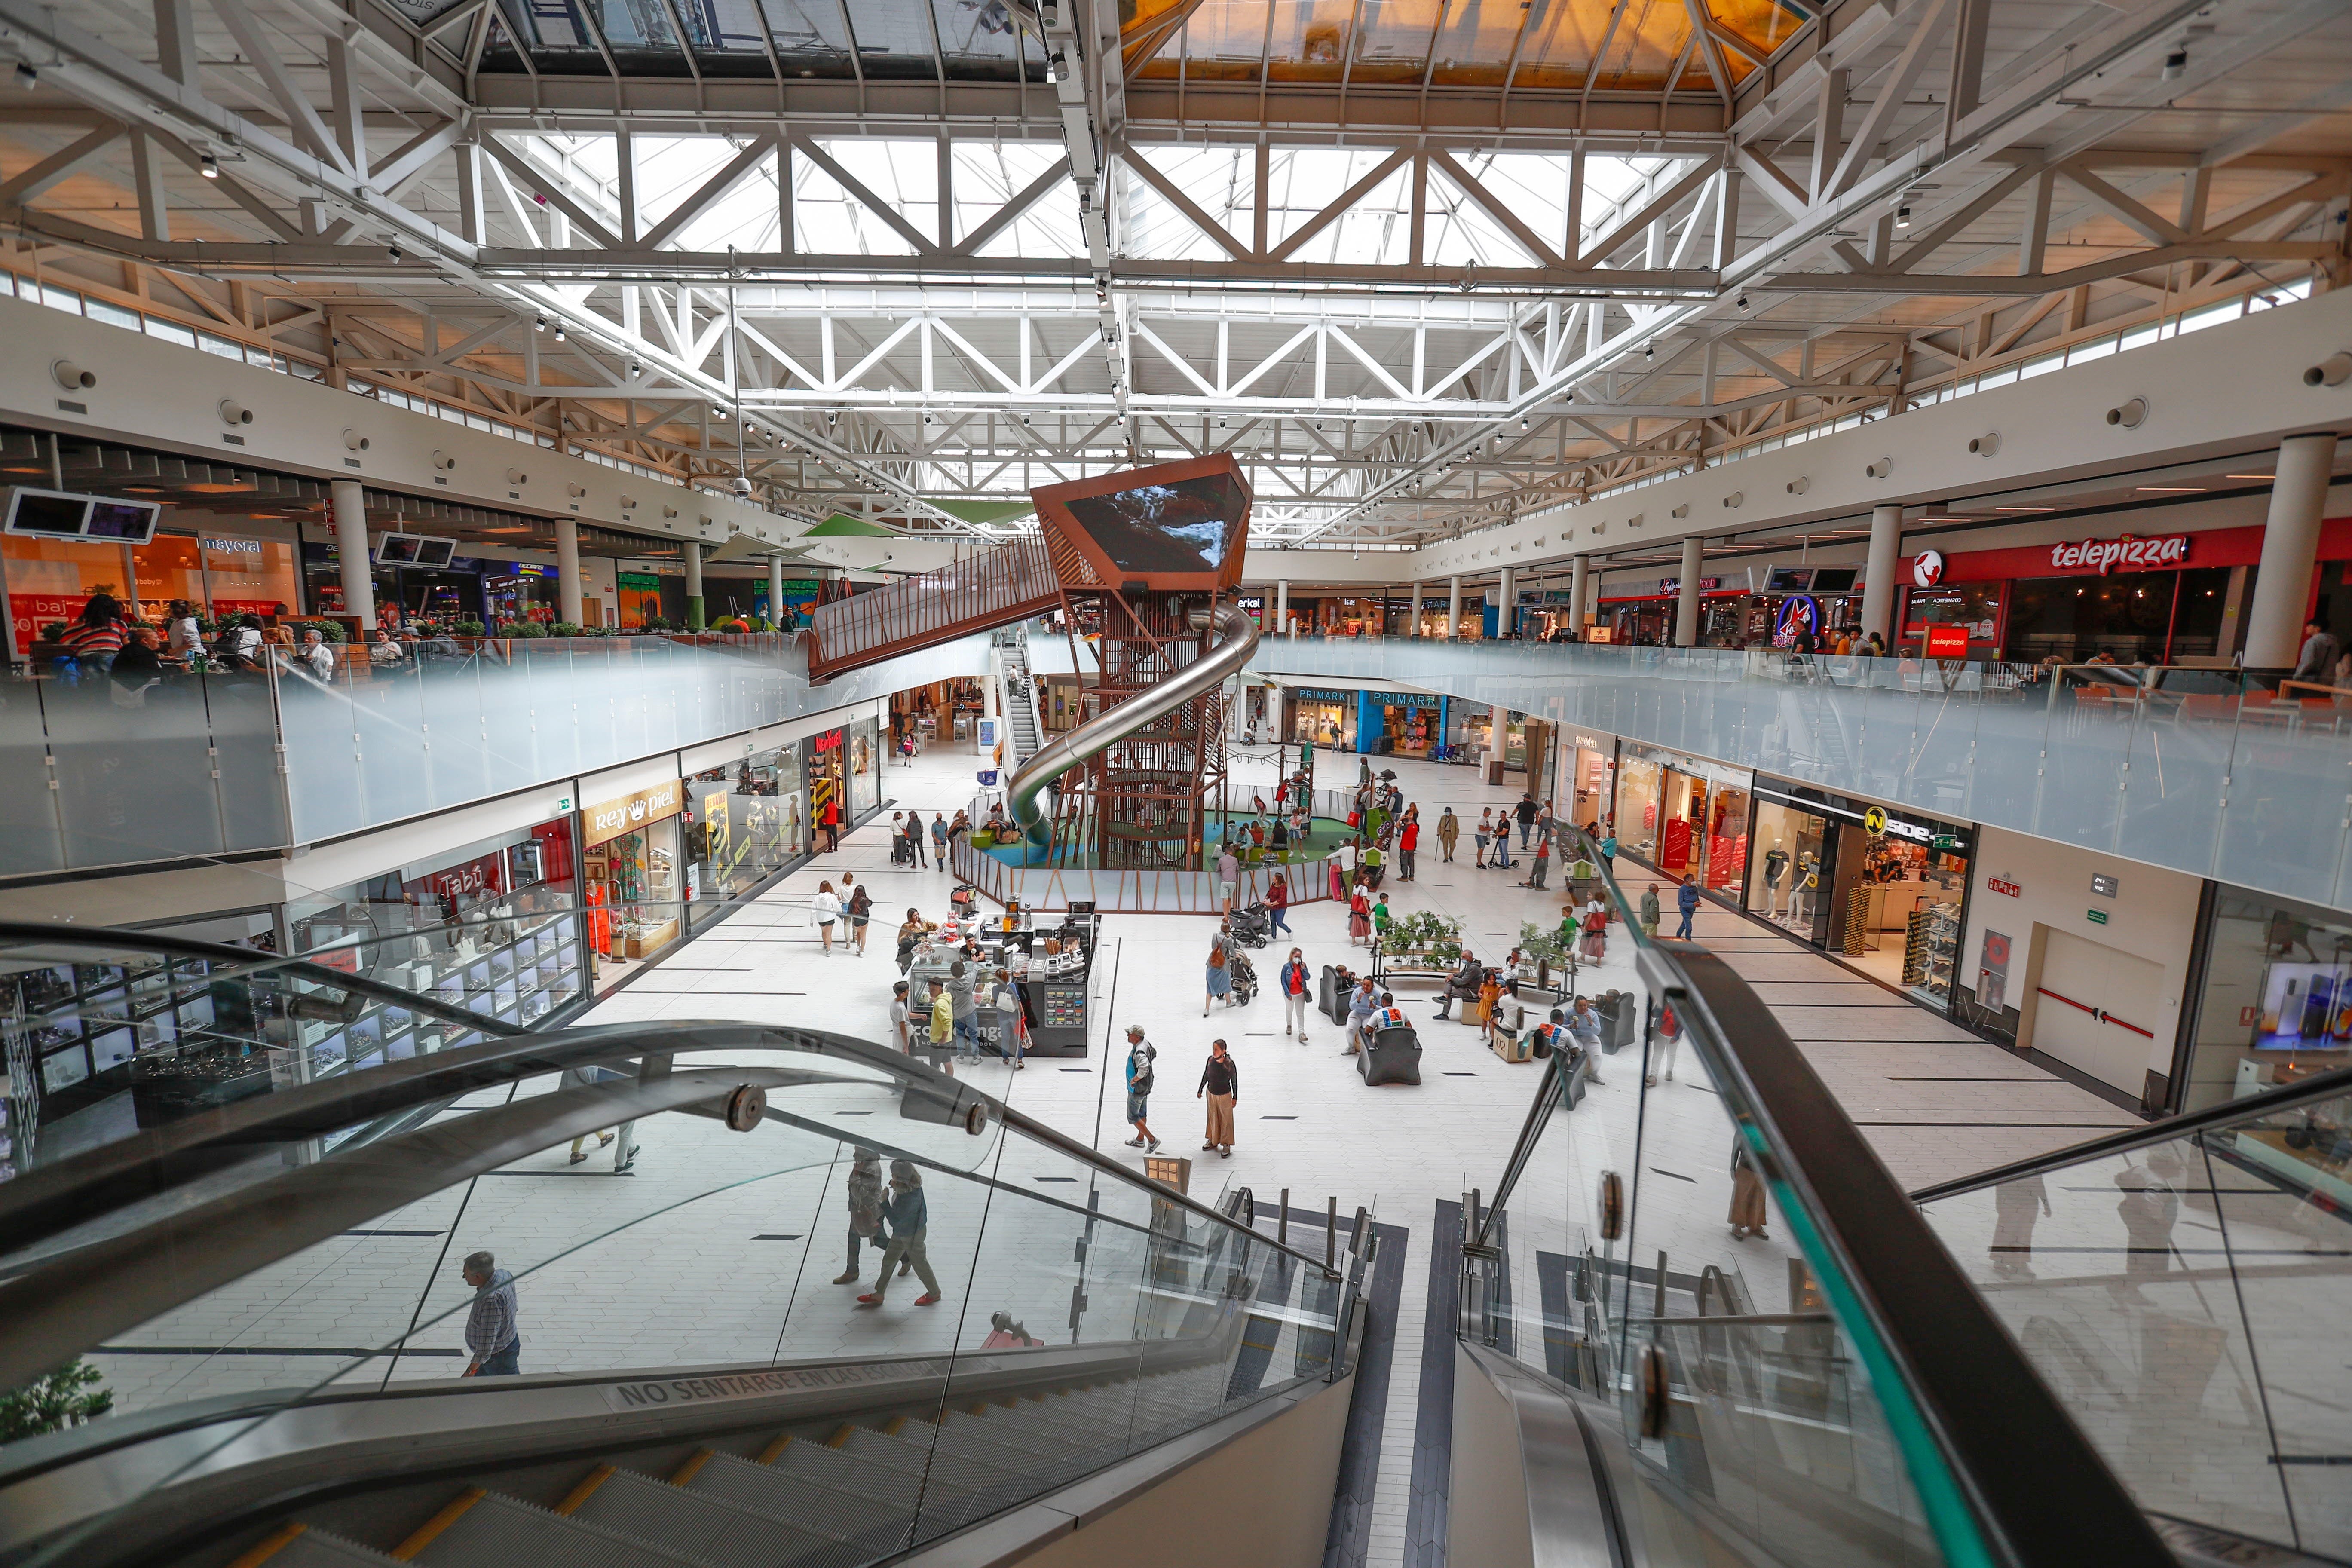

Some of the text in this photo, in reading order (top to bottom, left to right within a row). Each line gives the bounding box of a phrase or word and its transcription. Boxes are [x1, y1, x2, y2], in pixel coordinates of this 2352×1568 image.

[205, 538, 263, 554] mayoral
[2051, 536, 2183, 574] telepizza
[36, 600, 67, 615] baj
[1932, 639, 1964, 647] telepizza
[1300, 690, 1345, 701] PRIMARK
[1374, 693, 1436, 706] PRIMARK
[1575, 735, 1597, 749] PANDORA
[438, 865, 482, 898] Tabú
[1496, 1037, 1506, 1053] 02
[617, 1383, 669, 1406] NO
[671, 1372, 797, 1400] SENTARSE
[797, 1369, 828, 1387] EN
[829, 1368, 863, 1384] LAS
